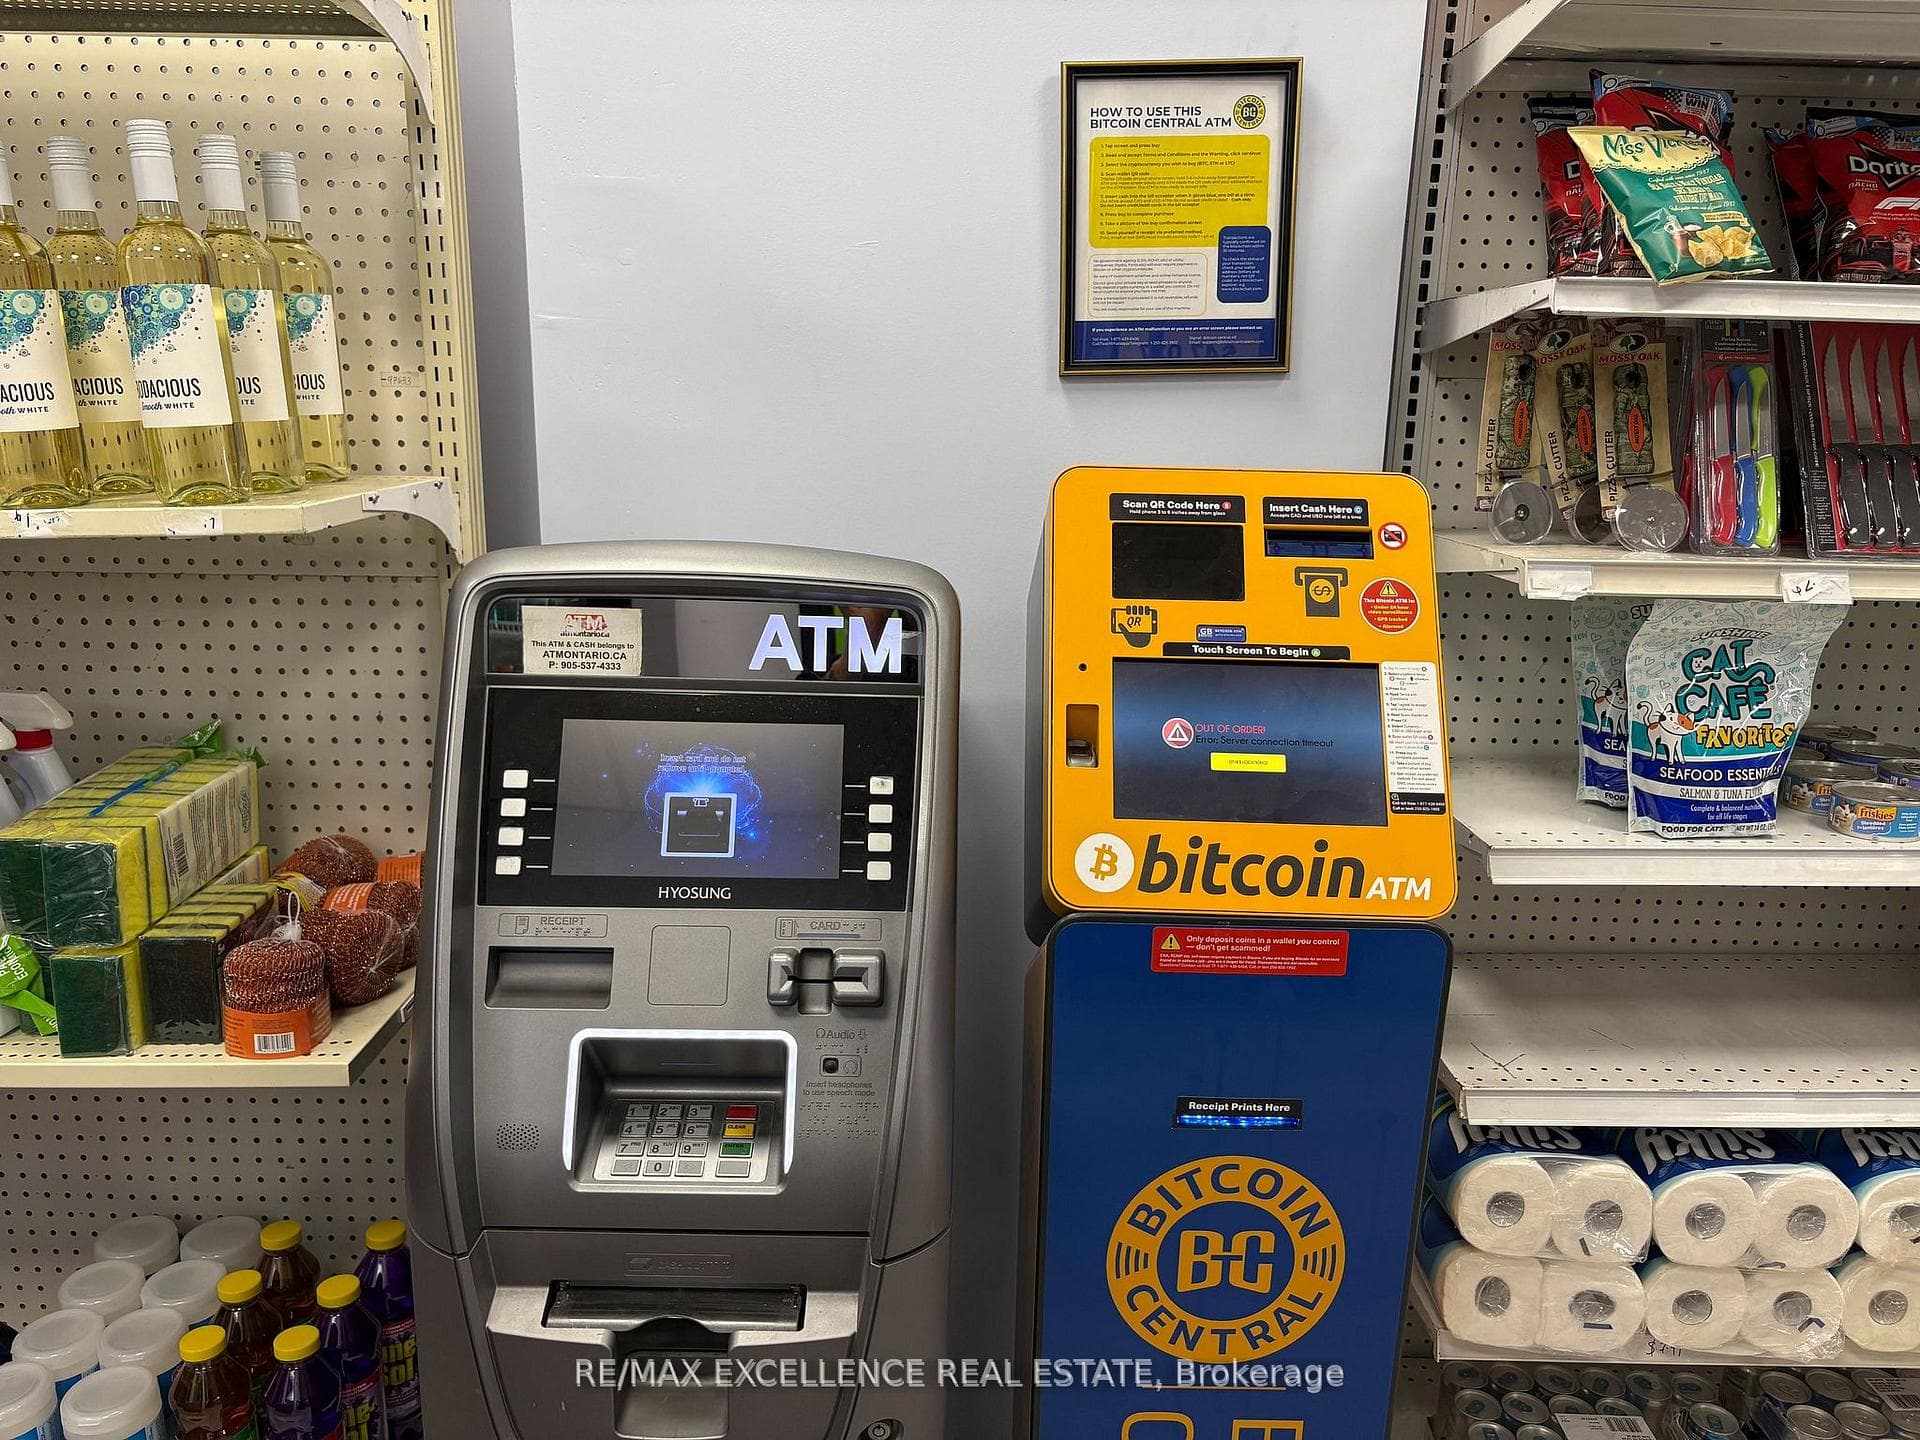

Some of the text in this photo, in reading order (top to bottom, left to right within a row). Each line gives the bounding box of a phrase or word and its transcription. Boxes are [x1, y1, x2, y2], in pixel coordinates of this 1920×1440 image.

[1090, 106, 1201, 117] HOW TO USE THIS
[1090, 117, 1232, 128] BITCOIN CENTRAL ATM
[1602, 134, 1644, 163] Miss
[1566, 344, 1587, 357] OAK
[1597, 352, 1662, 365] MOSSY OAK
[0, 382, 54, 402] ACIOUS
[75, 377, 124, 396] ACIOUS
[17, 406, 49, 414] WHITE
[164, 402, 195, 410] WHITE
[1484, 418, 1497, 492] PIZZA CUTTER
[1547, 431, 1573, 502] PIZZA CUTTER
[1604, 430, 1617, 502] PIZZA CUTTER
[1122, 499, 1220, 510] Scan QR Code Here
[1269, 503, 1353, 514] Insert Cash Here
[1631, 604, 1653, 619] SU
[1127, 616, 1142, 628] QR
[1200, 627, 1213, 635] GB
[1691, 628, 1772, 642] SUNSHINE
[597, 642, 626, 650] belongs
[748, 613, 904, 675] ATM
[542, 650, 627, 660] ATMONTARIO.CA
[1192, 645, 1309, 658] Touch Screen To Begin
[549, 660, 622, 670] P: 905-537-4333
[1681, 639, 1776, 684] CAT
[1195, 723, 1266, 734] OUT OF ORDER!
[1195, 735, 1334, 747] Error: Server connection timeout
[1660, 766, 1723, 781] SEAFOOD
[1604, 792, 1626, 801] FOOD
[1679, 787, 1713, 799] SALMON
[1714, 788, 1720, 799] &
[1722, 788, 1742, 799] TUNA
[1690, 804, 1744, 813] Complete balanced
[1859, 807, 1895, 820] Friskies
[1137, 833, 1432, 901] bitcoin ATM
[658, 886, 732, 901] HYOSUNG
[540, 916, 586, 926] RECEIPT
[810, 920, 841, 930] CARD
[1186, 935, 1205, 944] Only
[1205, 936, 1234, 945] deposit
[826, 1029, 856, 1040] Audio
[828, 1081, 873, 1089] headphones
[629, 1107, 698, 1116] 1 2 3
[1188, 1101, 1291, 1113] Receipt Prints Here
[625, 1125, 633, 1134] 4
[655, 1125, 664, 1134] 5
[687, 1126, 695, 1134] 6
[620, 1144, 692, 1154] 7 8 9
[1634, 1126, 1777, 1173] Silky
[654, 1162, 662, 1171] 0
[1126, 1162, 1331, 1239] BITCOIN
[1125, 1283, 1323, 1356] CENTRAL
